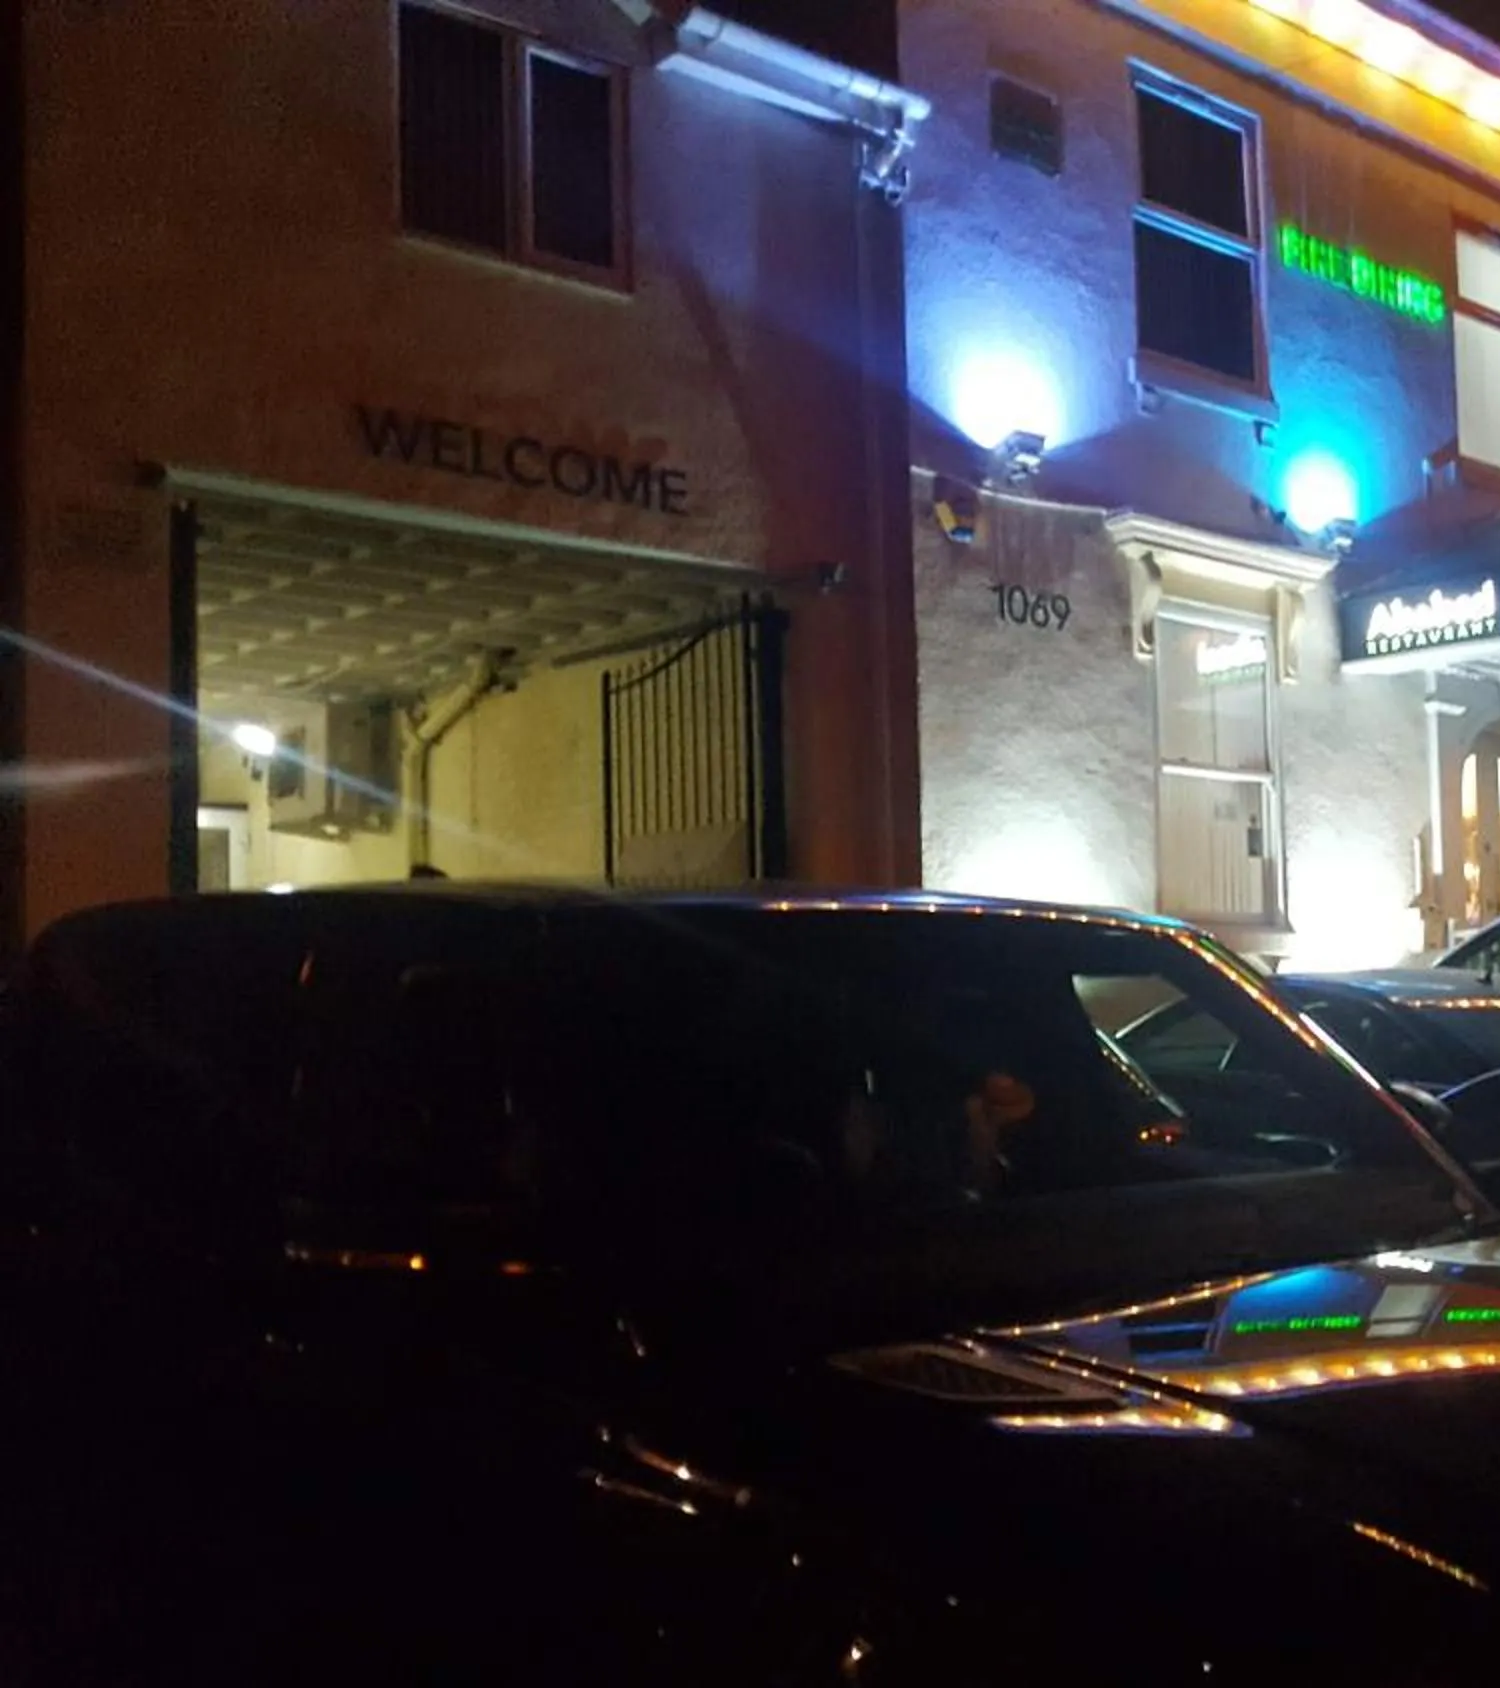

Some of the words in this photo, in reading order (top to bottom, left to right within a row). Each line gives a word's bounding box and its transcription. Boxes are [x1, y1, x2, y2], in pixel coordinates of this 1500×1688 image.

[355, 404, 690, 516] WELCOME
[987, 583, 1071, 631] 1069
[1367, 617, 1497, 655] RESTAURANT
